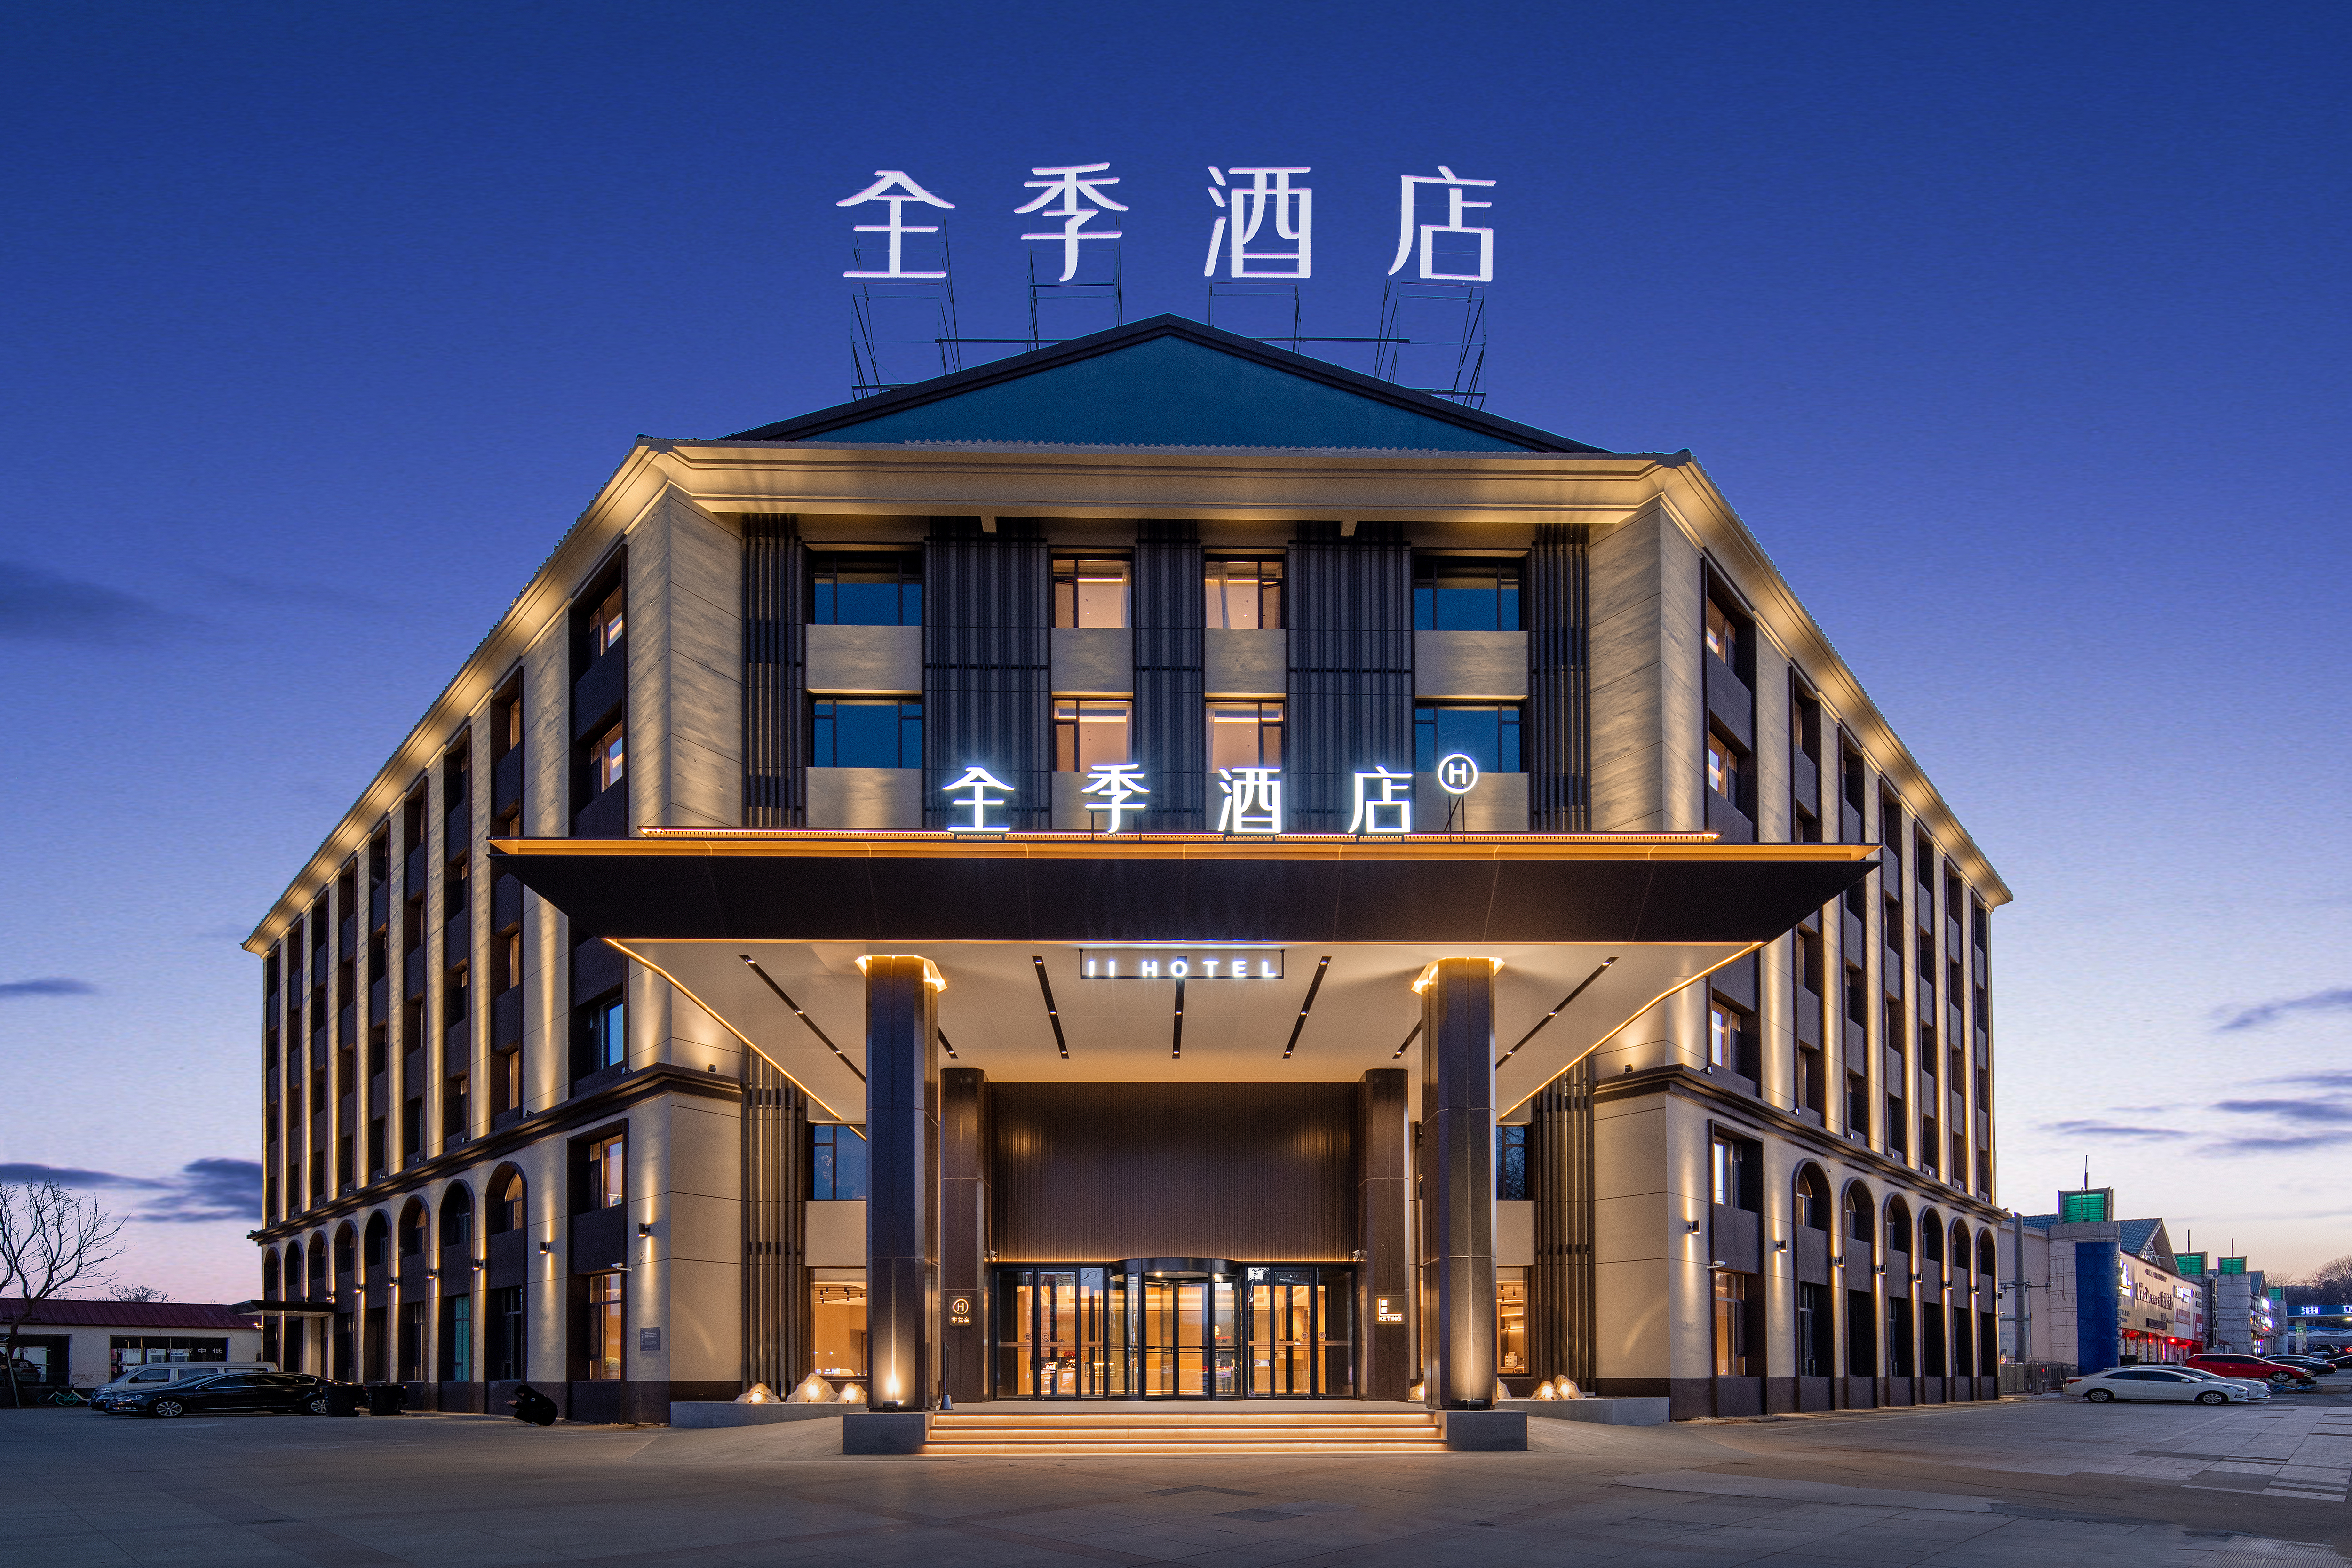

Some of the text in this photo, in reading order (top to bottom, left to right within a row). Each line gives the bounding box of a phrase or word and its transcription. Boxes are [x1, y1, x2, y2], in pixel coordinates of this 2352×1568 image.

[835, 162, 1498, 282] 全季酒店
[942, 764, 1413, 834] 全季酒店
[1142, 960, 1277, 977] HOTEL
